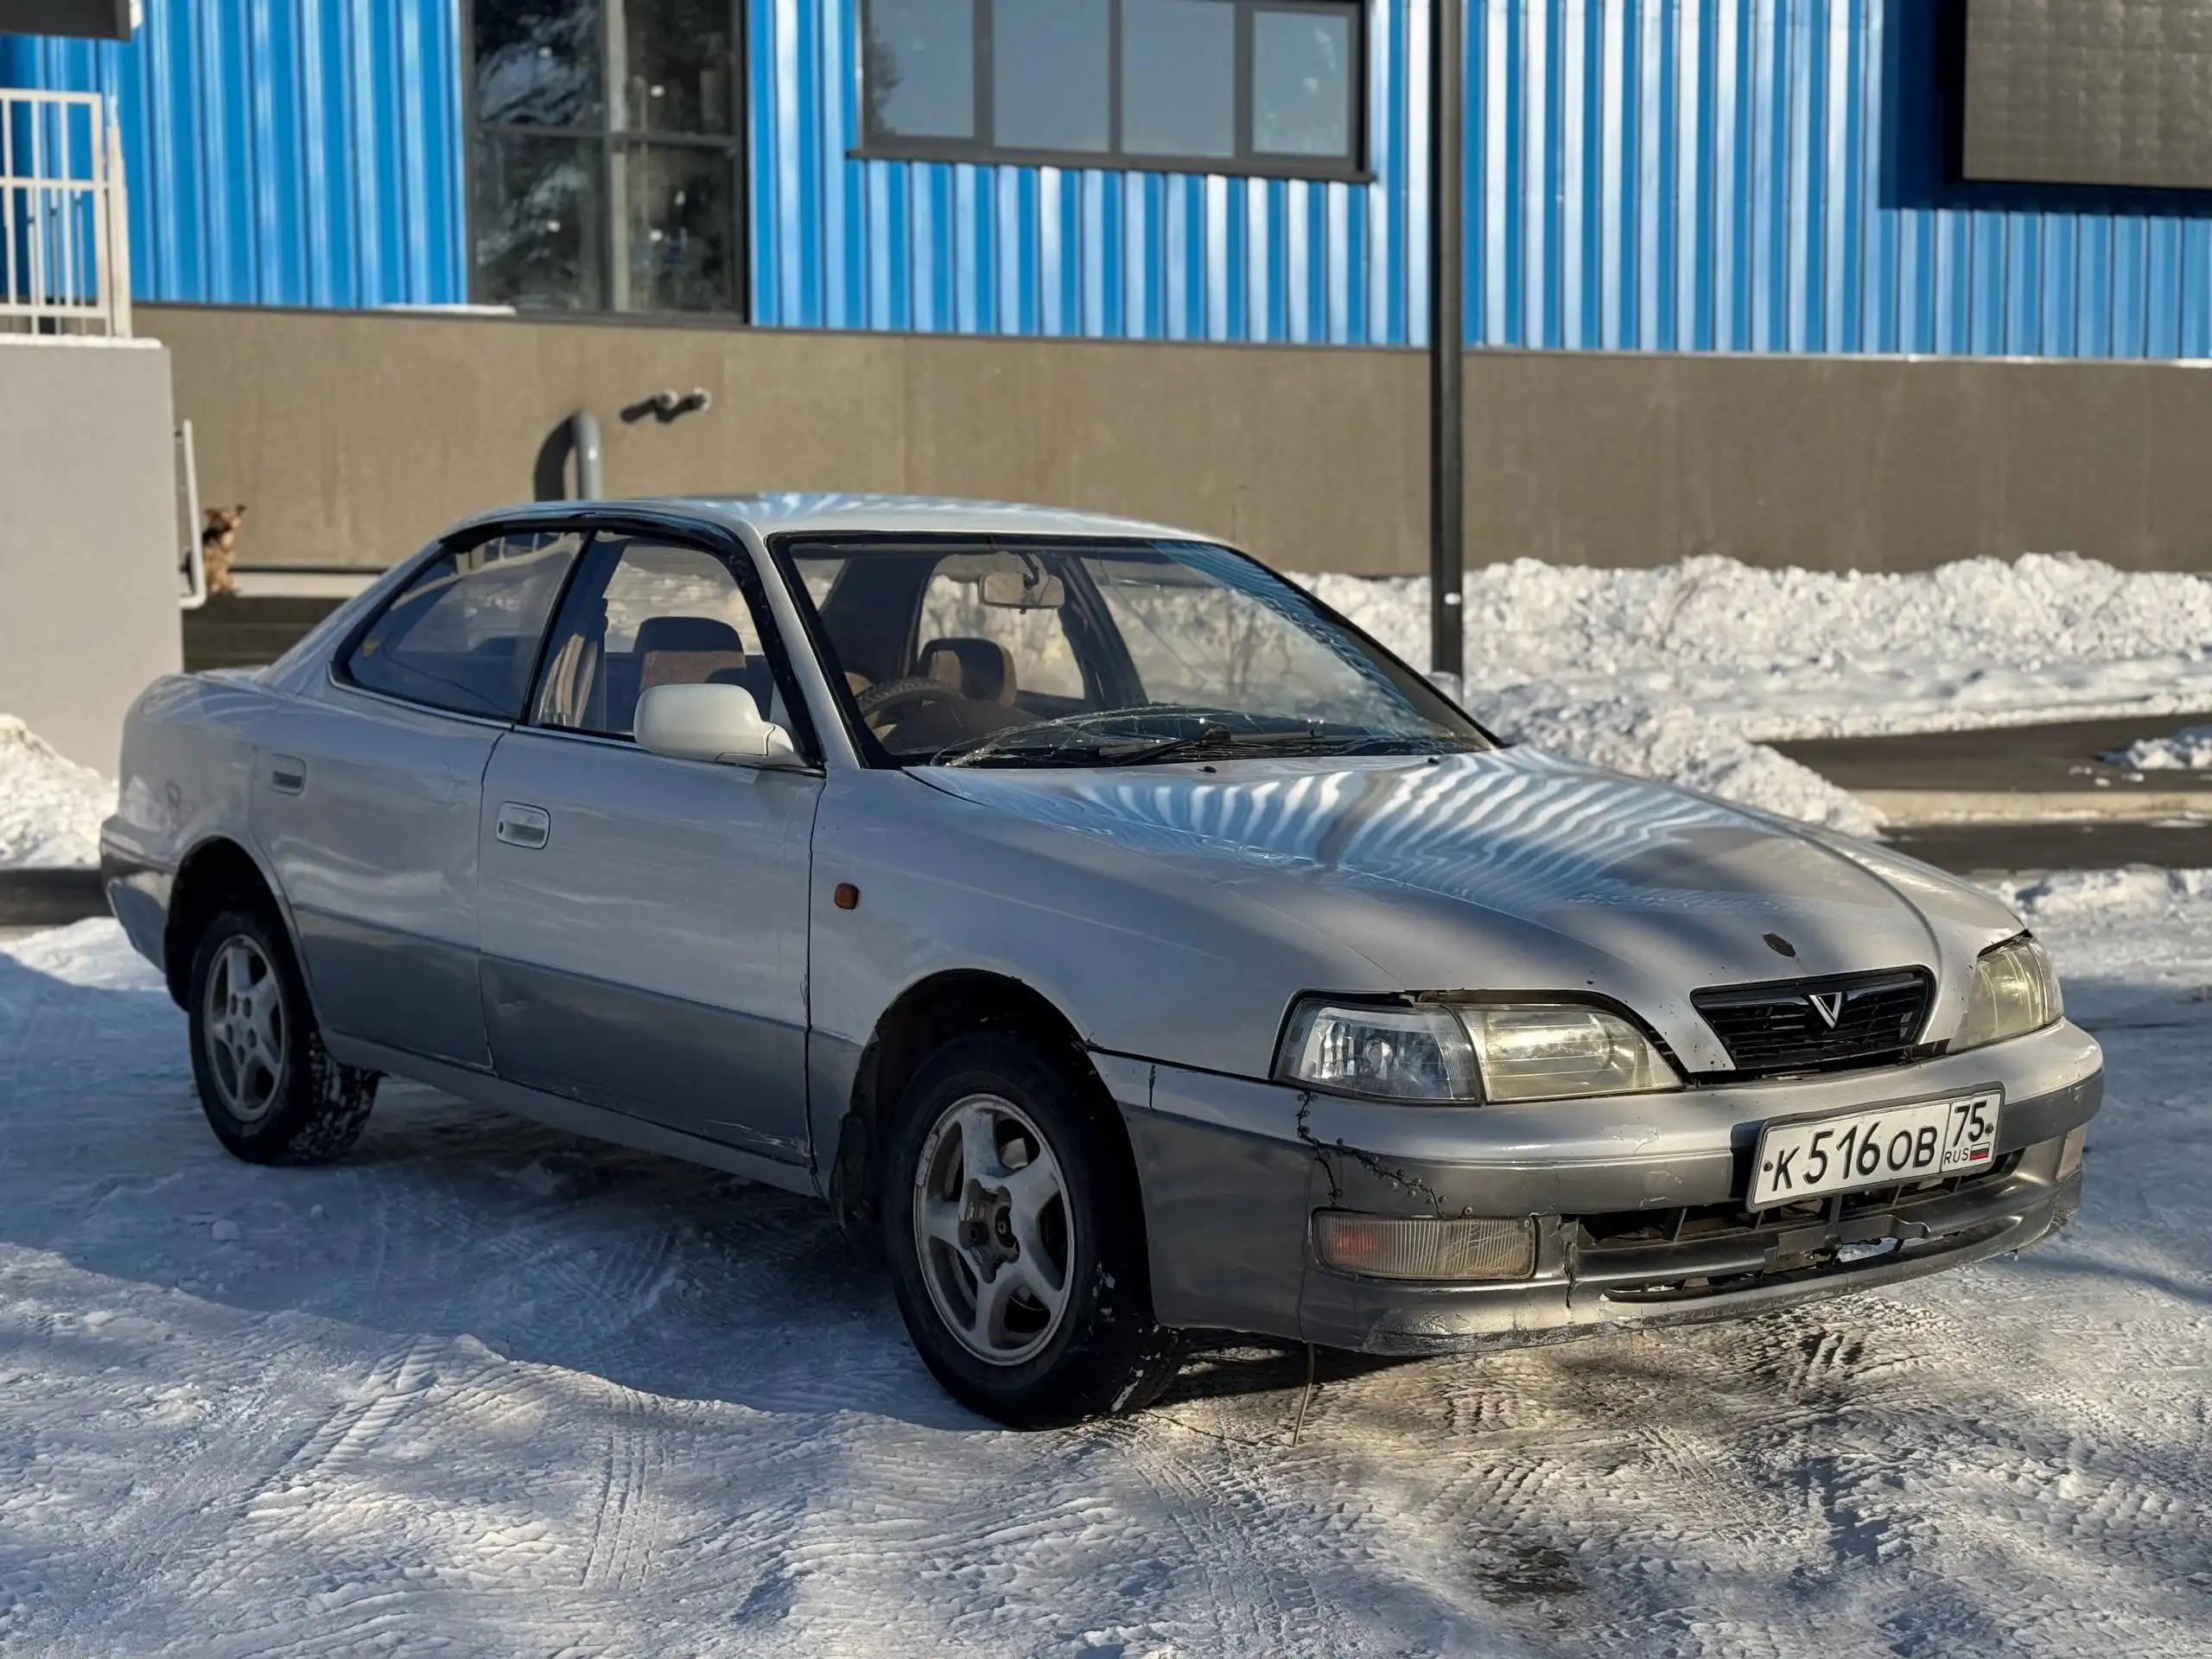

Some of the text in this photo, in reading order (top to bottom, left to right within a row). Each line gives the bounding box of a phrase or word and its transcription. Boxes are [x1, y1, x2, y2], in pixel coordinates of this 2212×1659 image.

[1773, 1101, 1987, 1191] К516ОВ 75
[1943, 1147, 1969, 1165] RUS
